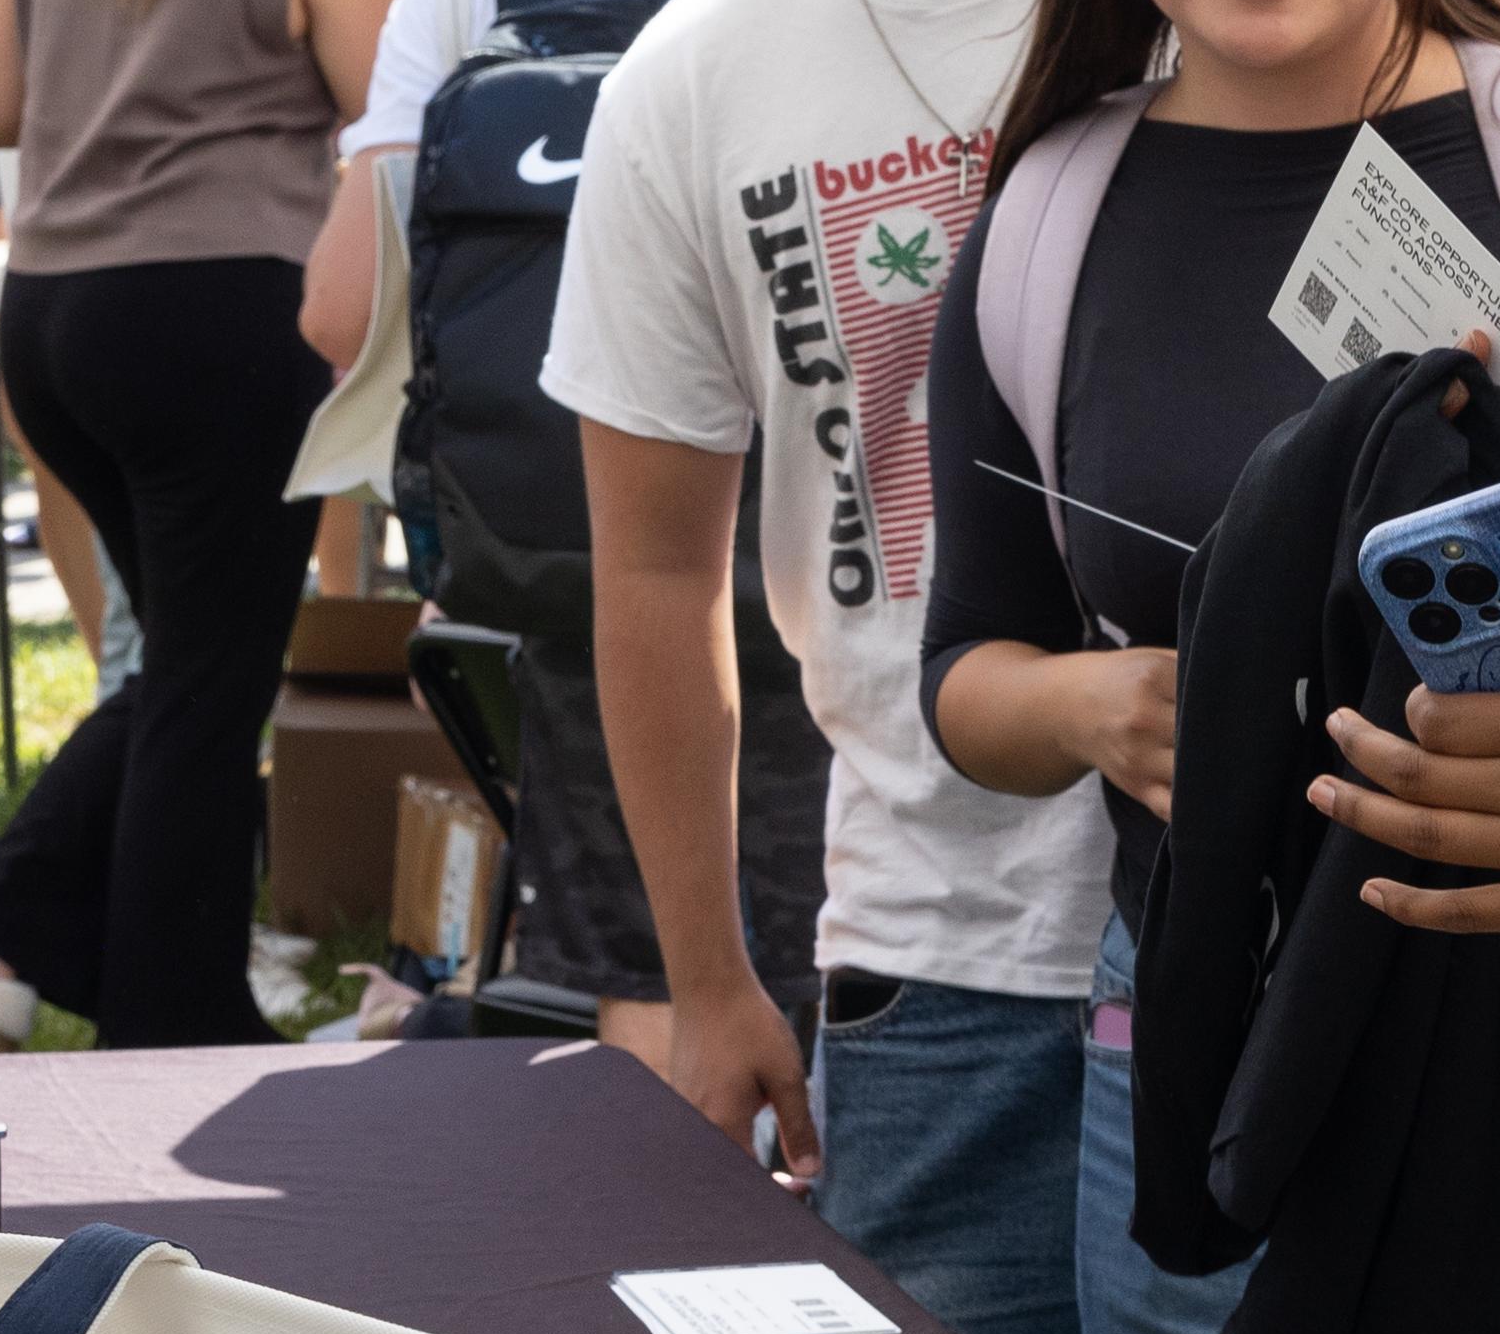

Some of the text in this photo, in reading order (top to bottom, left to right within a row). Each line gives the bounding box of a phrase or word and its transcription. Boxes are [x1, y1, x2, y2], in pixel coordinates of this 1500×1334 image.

[1358, 176, 1389, 208] A&F
[1389, 205, 1414, 237] CO.
[1414, 231, 1473, 299] ACROSS
[1365, 161, 1431, 234] EXPLORE
[741, 165, 845, 387] STATE
